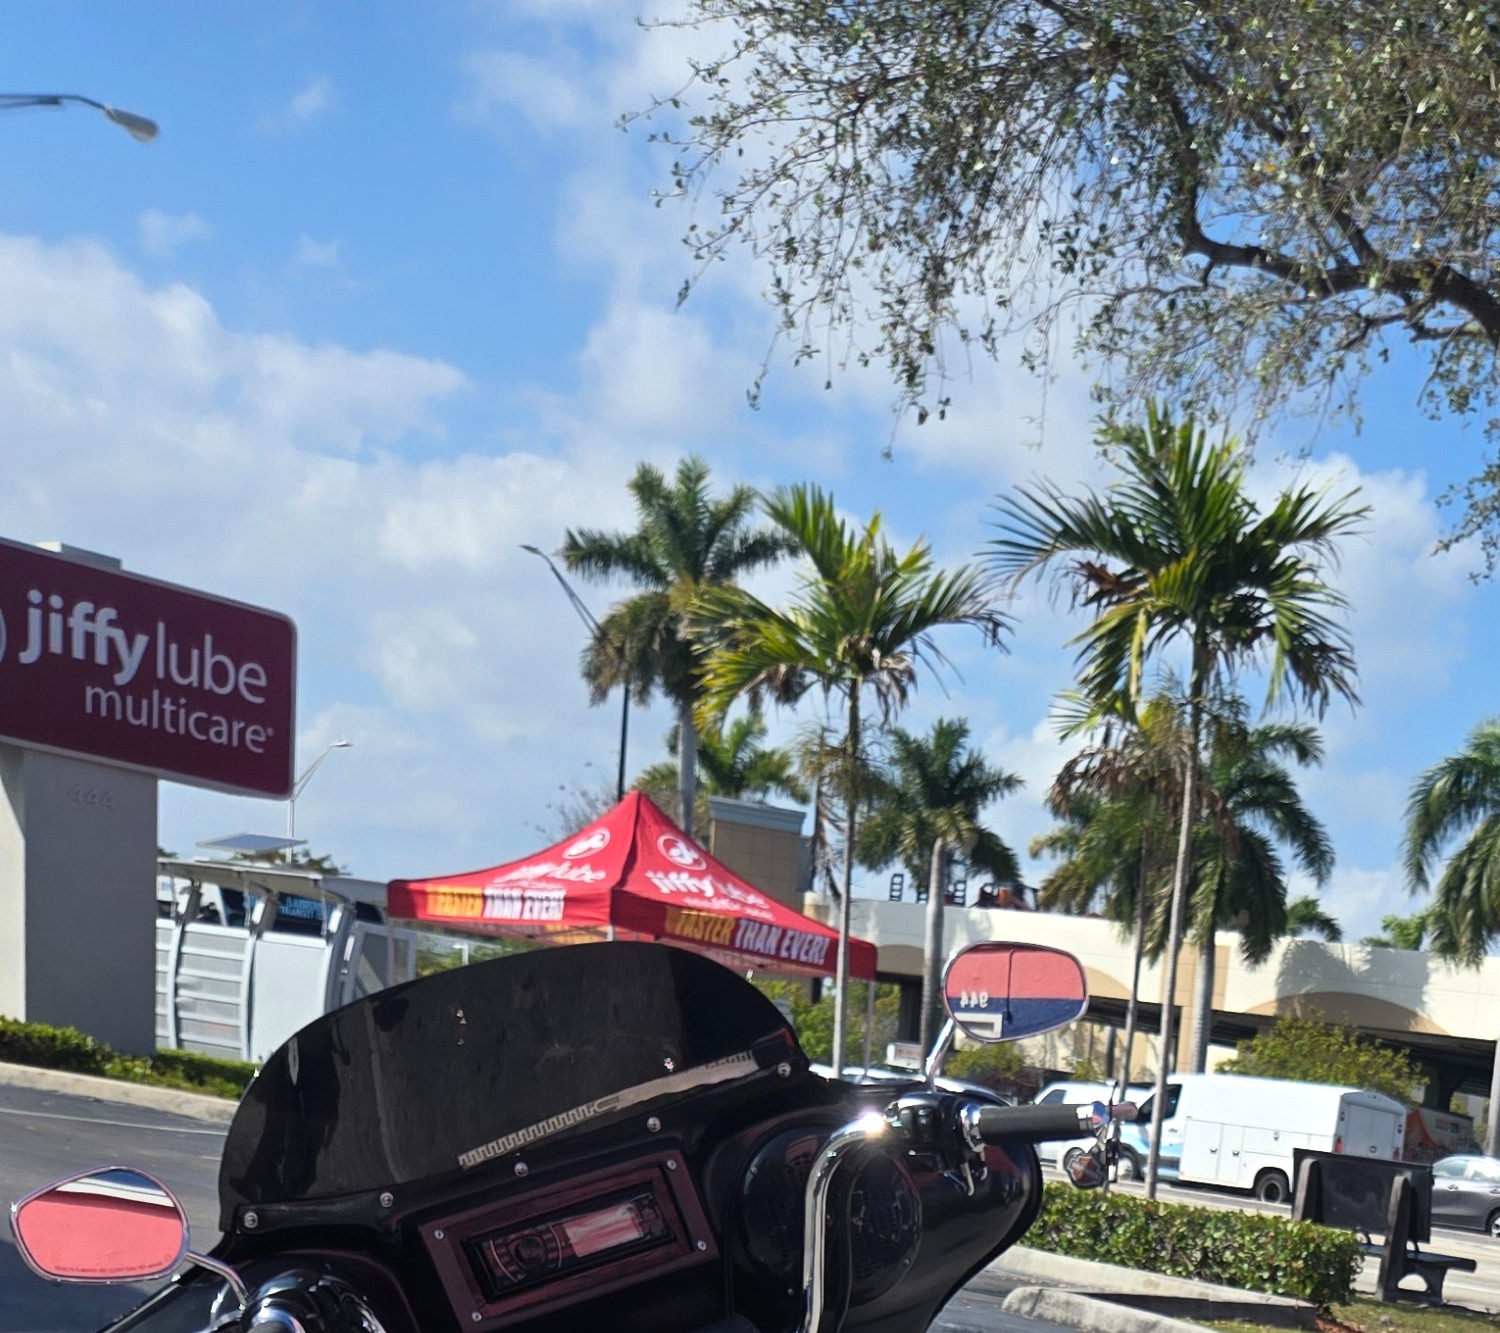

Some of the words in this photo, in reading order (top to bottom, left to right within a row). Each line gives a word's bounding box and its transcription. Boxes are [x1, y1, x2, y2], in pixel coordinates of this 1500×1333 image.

[19, 588, 149, 687] jiffy
[156, 620, 268, 705] lube
[84, 684, 268, 755] multicare
[645, 870, 714, 898] jiffy
[734, 918, 781, 956] THAN
[780, 930, 830, 965] EVER!
